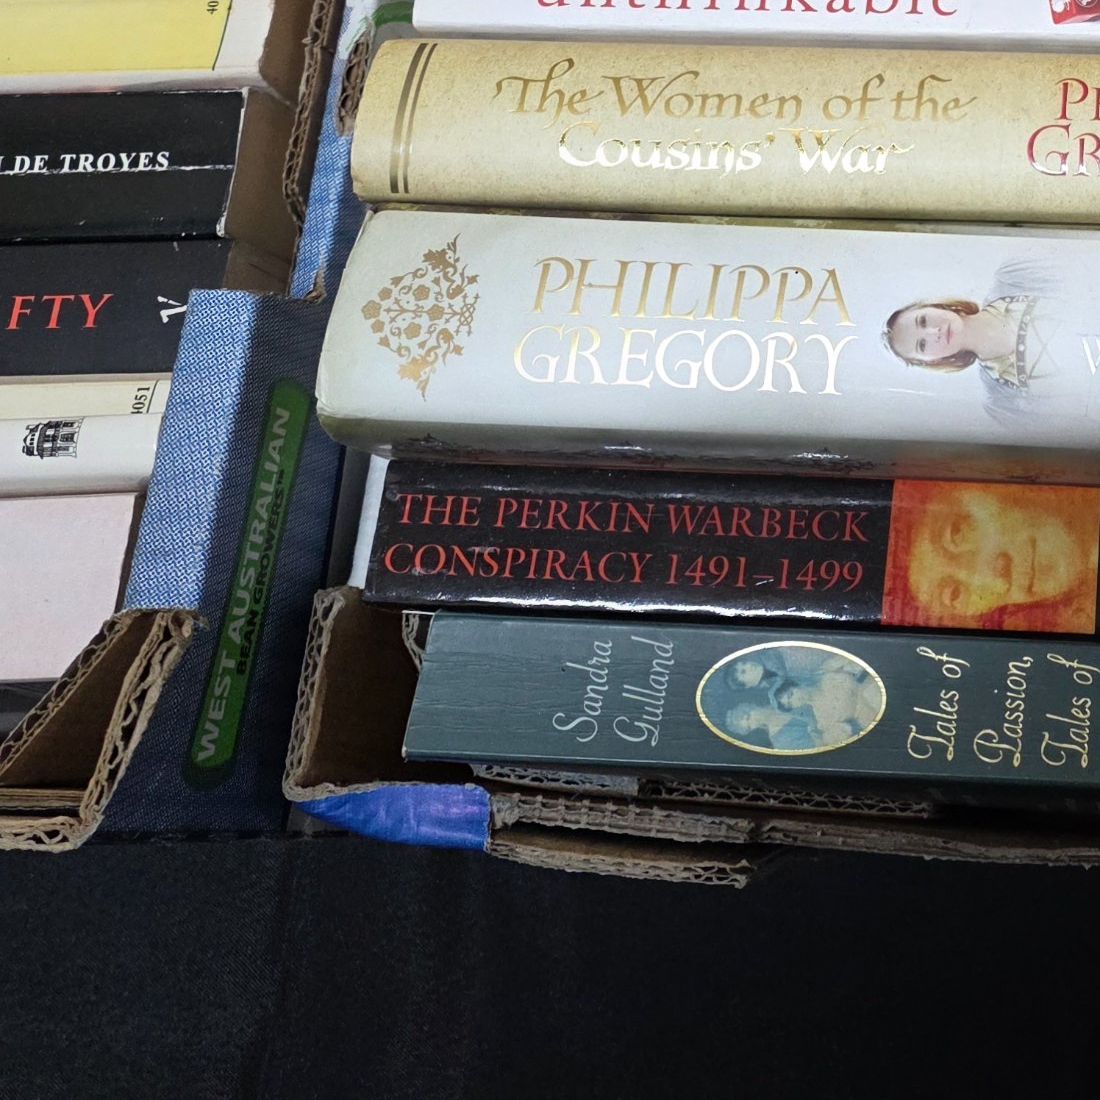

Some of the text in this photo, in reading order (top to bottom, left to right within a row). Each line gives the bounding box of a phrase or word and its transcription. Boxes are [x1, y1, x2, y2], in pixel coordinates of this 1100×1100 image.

[494, 57, 977, 128] The Women of the
[13, 151, 171, 175] DE TROYES
[781, 125, 915, 177] War
[6, 293, 114, 330] FTY
[529, 254, 860, 328] PHILIPPA
[512, 323, 860, 396] GREGORY
[394, 492, 871, 543] THE PERKIN WARBECK
[197, 407, 291, 761] WEST AUSTRALIAN
[383, 541, 654, 585] CONSPIRACY
[236, 605, 262, 676] BEAN
[551, 639, 614, 743] Sandra
[613, 635, 676, 748] Gulland
[906, 645, 971, 763] Tales of
[972, 653, 1035, 769] Passion,
[1039, 689, 1094, 769] Tales
